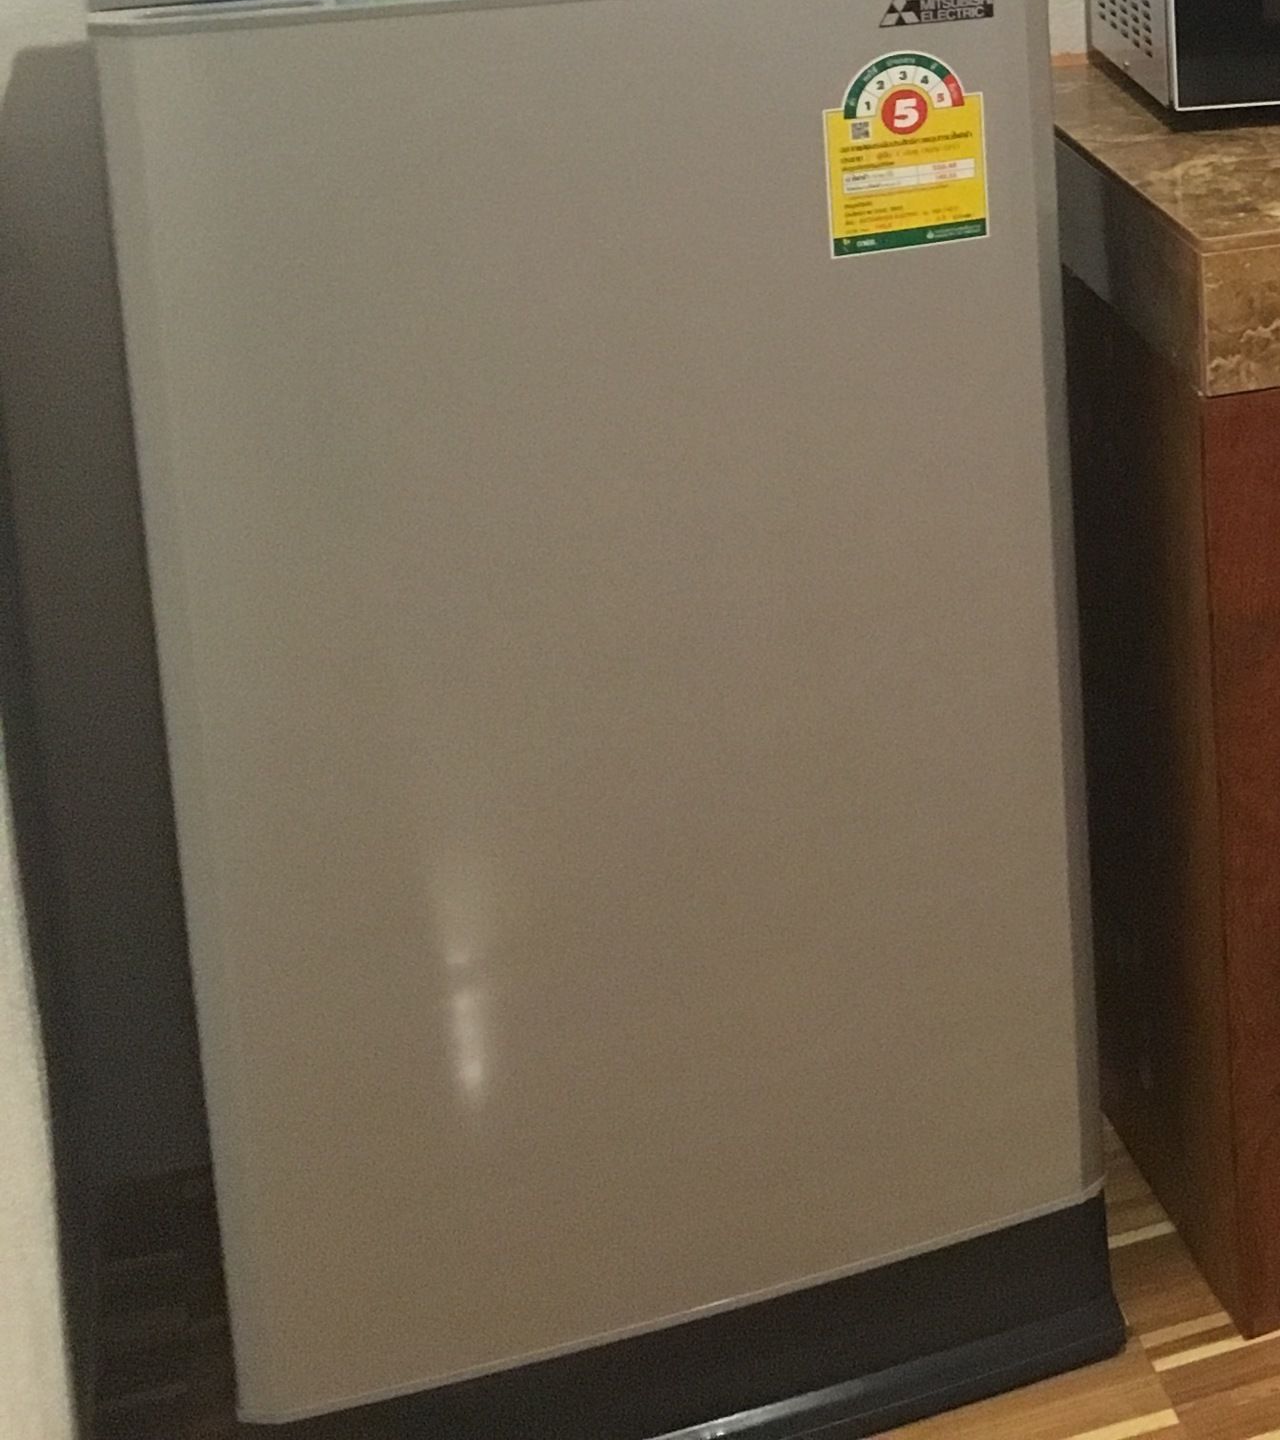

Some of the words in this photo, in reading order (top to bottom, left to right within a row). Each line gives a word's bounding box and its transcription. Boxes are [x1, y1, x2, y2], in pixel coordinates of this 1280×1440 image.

[920, 6, 985, 22] ELECTRIC
[864, 101, 871, 111] 1
[876, 80, 885, 90] 2
[898, 71, 907, 81] 3
[920, 75, 929, 85] 4
[937, 93, 945, 103] 5
[893, 98, 919, 128] 5
